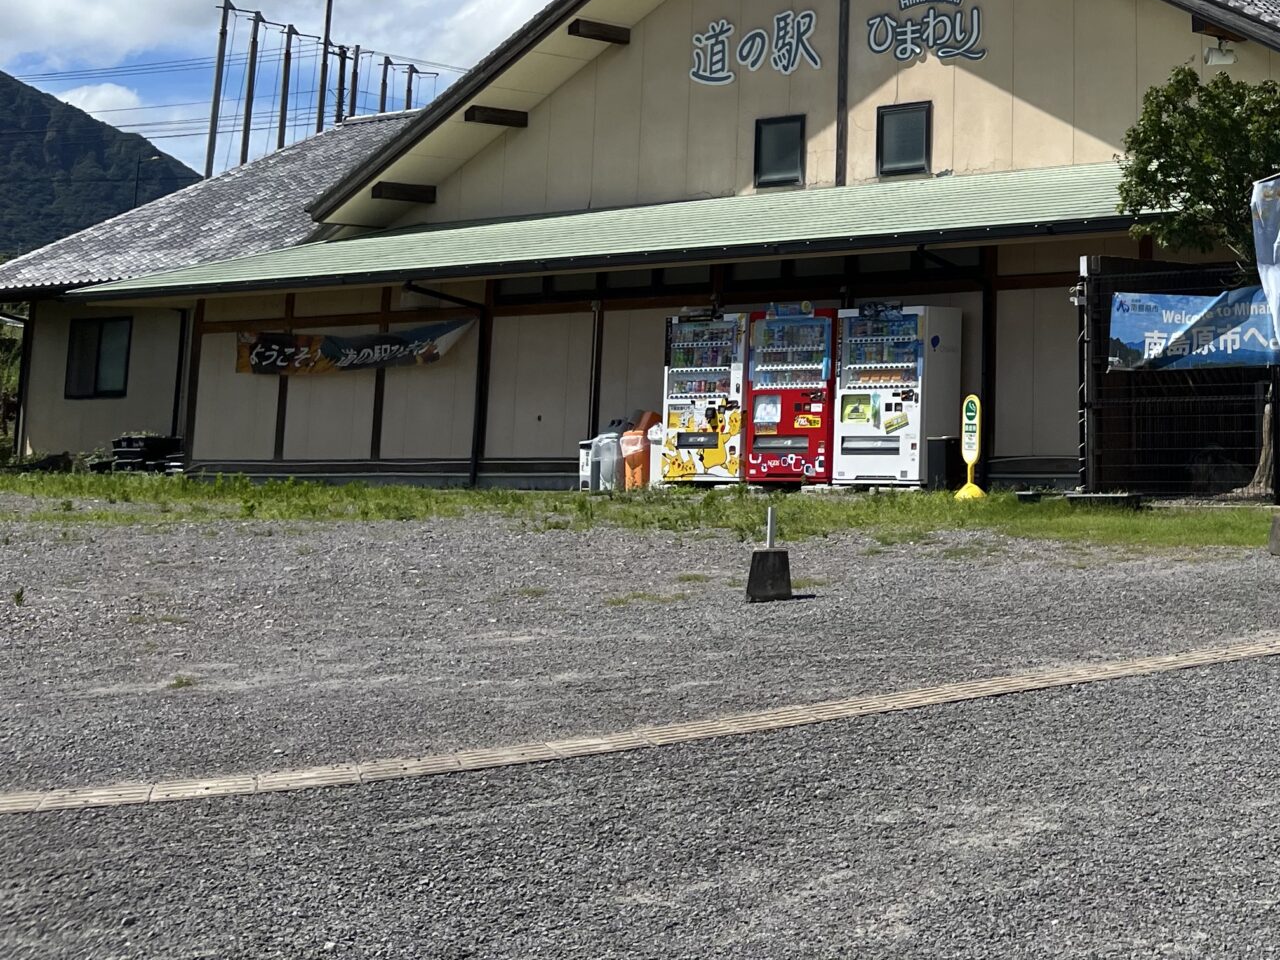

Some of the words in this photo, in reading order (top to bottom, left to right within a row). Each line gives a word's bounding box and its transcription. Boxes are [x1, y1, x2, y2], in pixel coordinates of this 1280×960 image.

[690, 10, 822, 85] 道の駅
[867, 7, 987, 61] ひまわり
[1217, 305, 1232, 318] to
